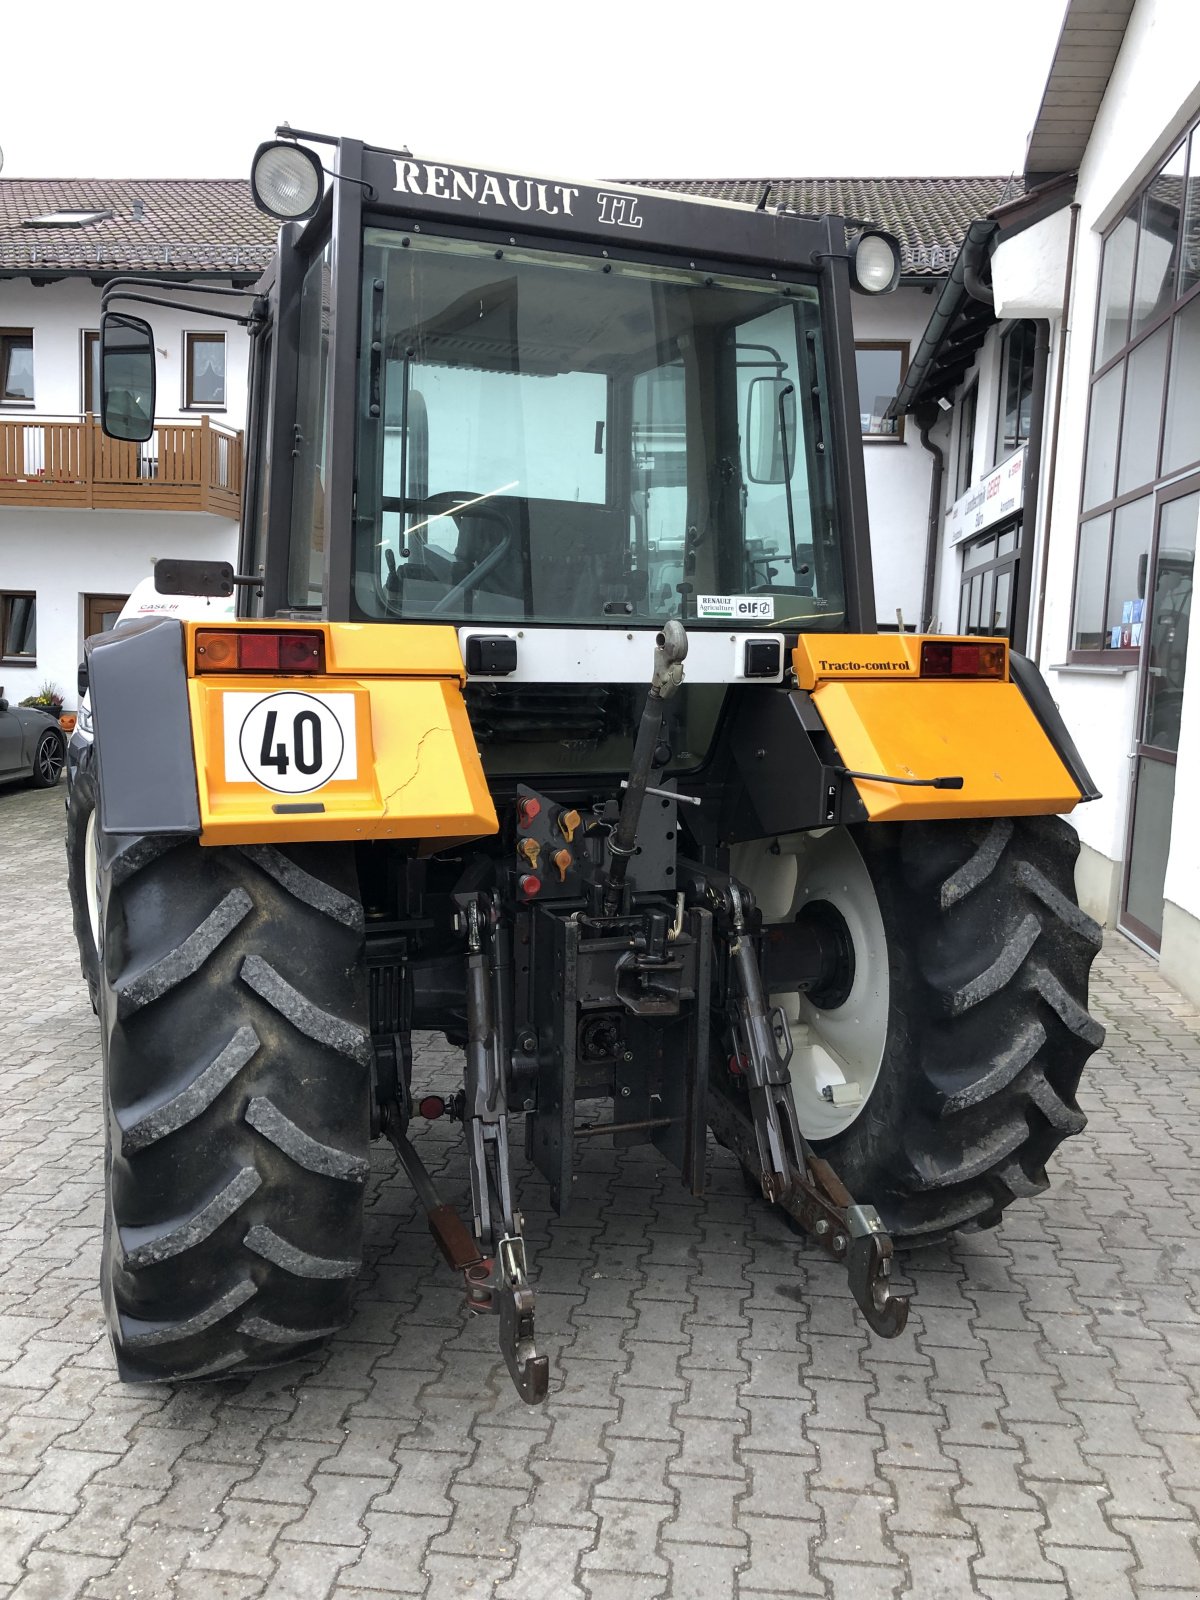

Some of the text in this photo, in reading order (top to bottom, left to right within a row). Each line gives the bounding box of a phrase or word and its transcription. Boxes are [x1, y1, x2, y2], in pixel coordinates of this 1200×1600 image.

[393, 158, 643, 228] RENAULT TL
[702, 597, 732, 605] RENAULT
[700, 604, 734, 612] Agriculture
[738, 602, 758, 614] elf
[818, 660, 910, 671] Tracto-control
[260, 710, 323, 775] 40
